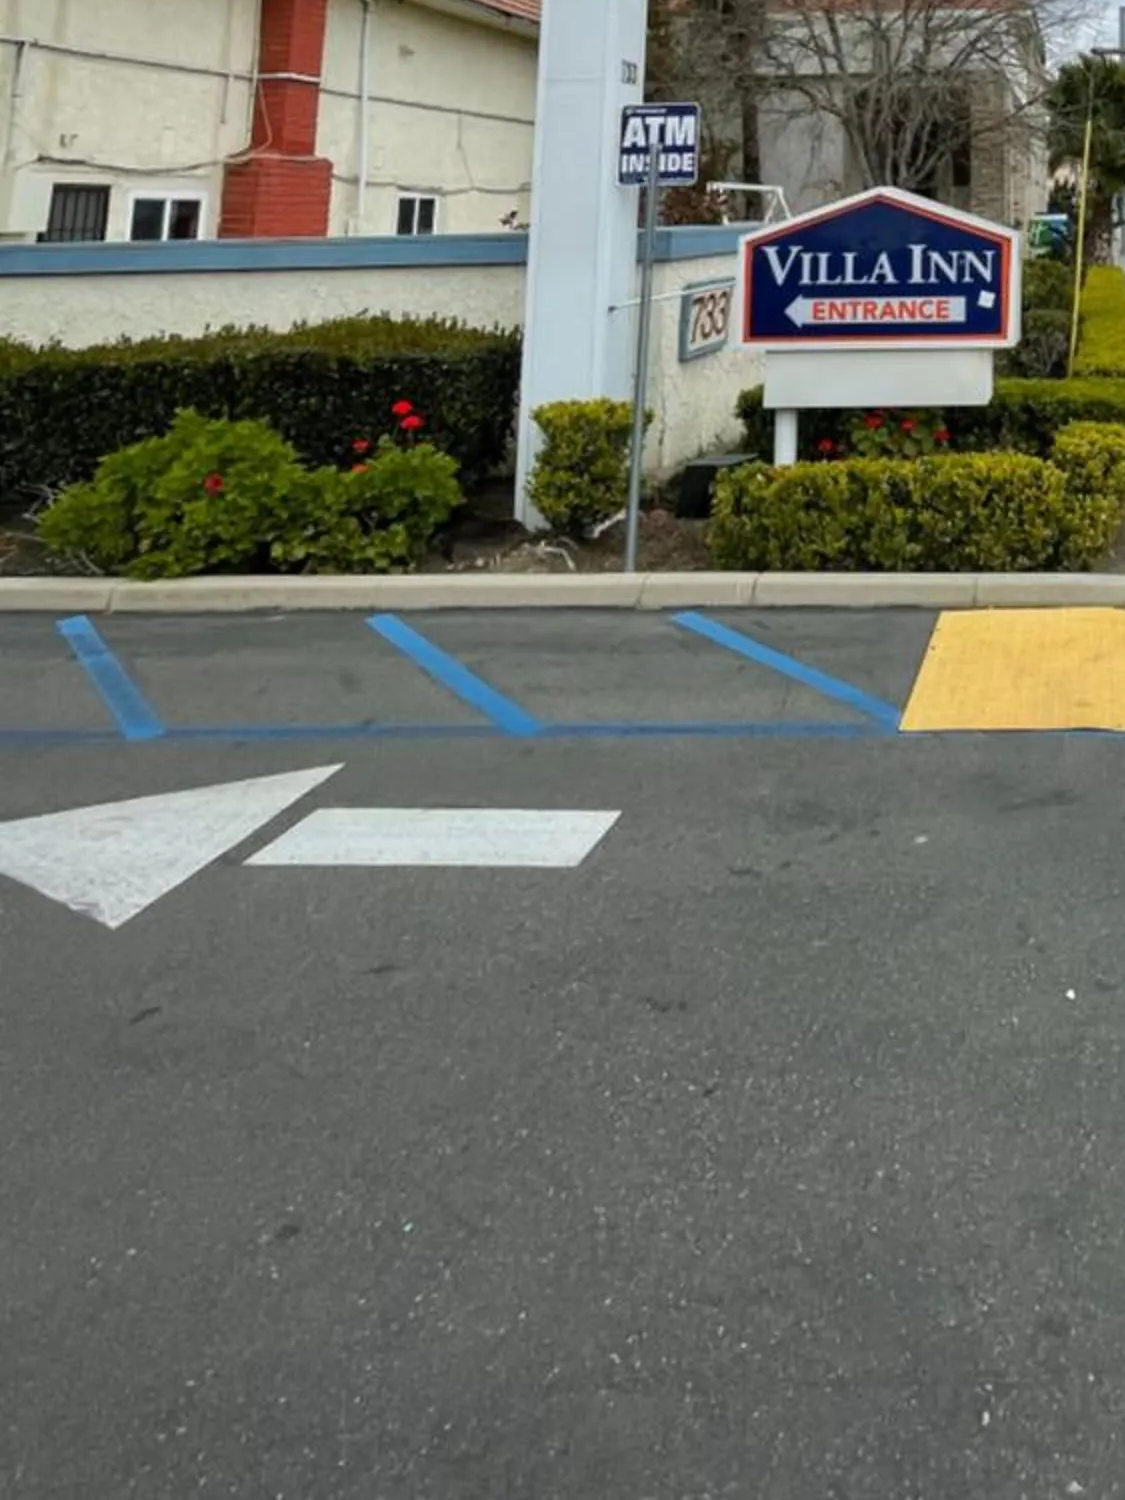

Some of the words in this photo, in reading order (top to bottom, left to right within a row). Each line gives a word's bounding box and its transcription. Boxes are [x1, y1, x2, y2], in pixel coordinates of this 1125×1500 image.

[622, 115, 695, 147] ATM
[761, 245, 898, 287] VILLA
[906, 243, 996, 284] INN
[691, 290, 730, 344] 733
[812, 299, 951, 321] ENTRANCE
